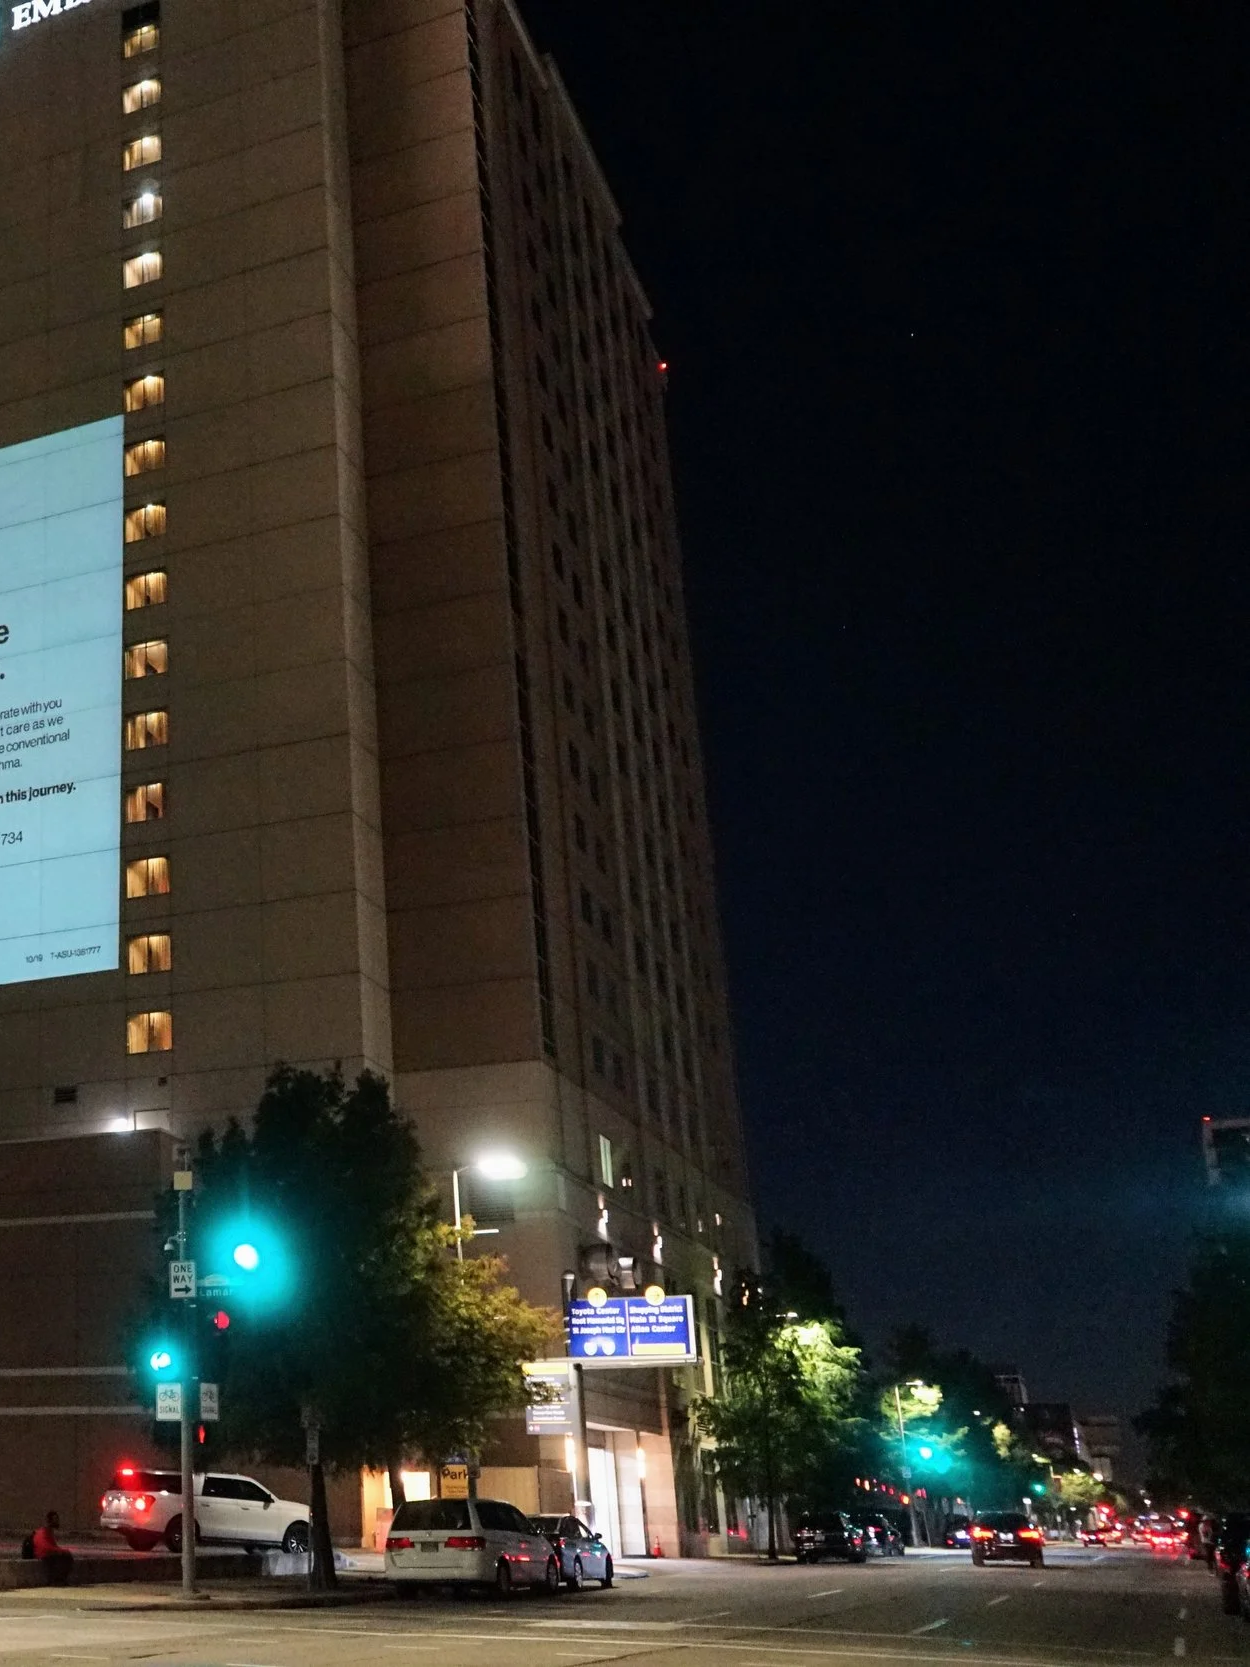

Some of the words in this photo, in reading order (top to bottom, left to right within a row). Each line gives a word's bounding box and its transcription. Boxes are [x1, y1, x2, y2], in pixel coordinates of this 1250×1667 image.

[21, 701, 42, 715] with
[43, 699, 62, 713] you
[6, 722, 30, 736] care
[33, 719, 45, 730] as
[47, 715, 64, 726] we
[6, 729, 70, 752] conventional
[5, 789, 27, 803] this
[28, 782, 77, 801] journey.
[0, 830, 23, 846] 734
[173, 1264, 193, 1273] ONE
[172, 1275, 194, 1284] WAY
[200, 1288, 234, 1297] Lamar
[571, 1308, 595, 1316] Toyota
[651, 1325, 676, 1333] Center
